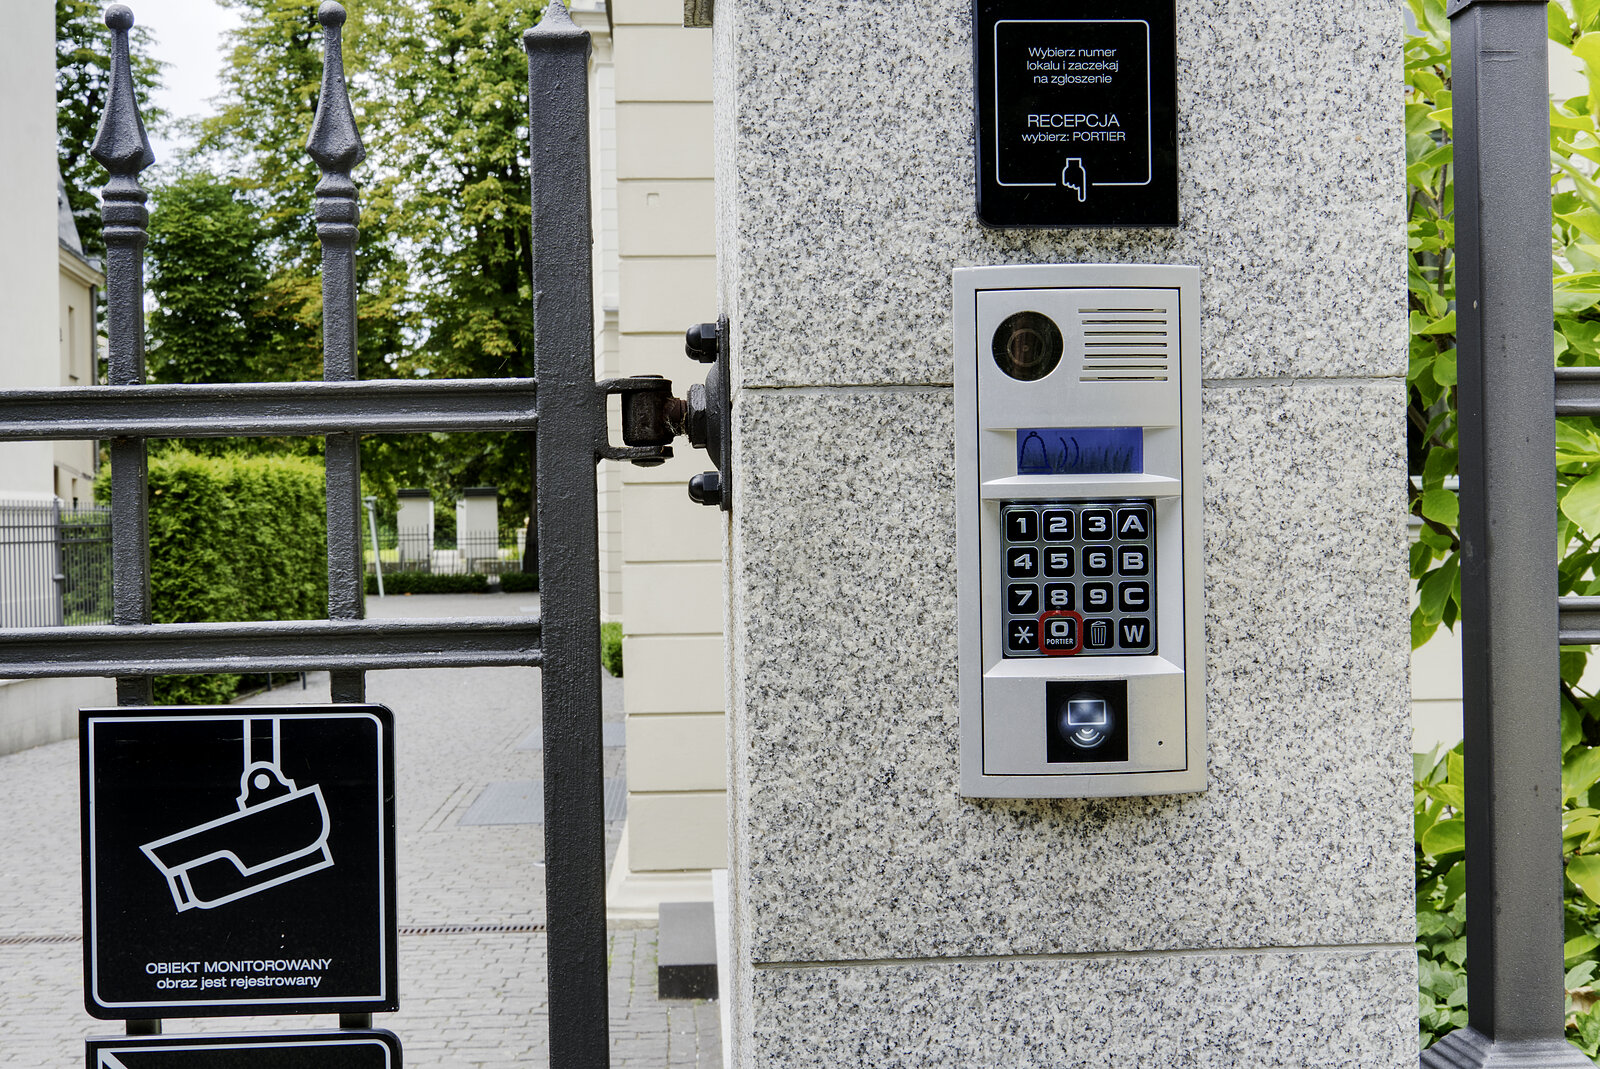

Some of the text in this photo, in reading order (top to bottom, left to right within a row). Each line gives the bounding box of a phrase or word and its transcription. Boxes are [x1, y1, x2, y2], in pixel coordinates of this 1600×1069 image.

[1028, 47, 1117, 60] Wybierz numer
[1026, 60, 1061, 71] lokalu
[1067, 59, 1119, 73] zaczekaj
[1033, 75, 1049, 84] na
[1027, 113, 1121, 128] RECEPCJA
[1021, 130, 1126, 144] wybierz: PORTIER
[1016, 514, 1145, 534] 1 2 3 A
[1013, 552, 1145, 570] 4 5 6 B
[1014, 587, 1145, 606] 7 8 9 C
[1050, 621, 1145, 643] 0 W
[145, 958, 333, 975] OBIEKT MONITOROWANY
[156, 975, 322, 991] obraz jest rejestrowany
